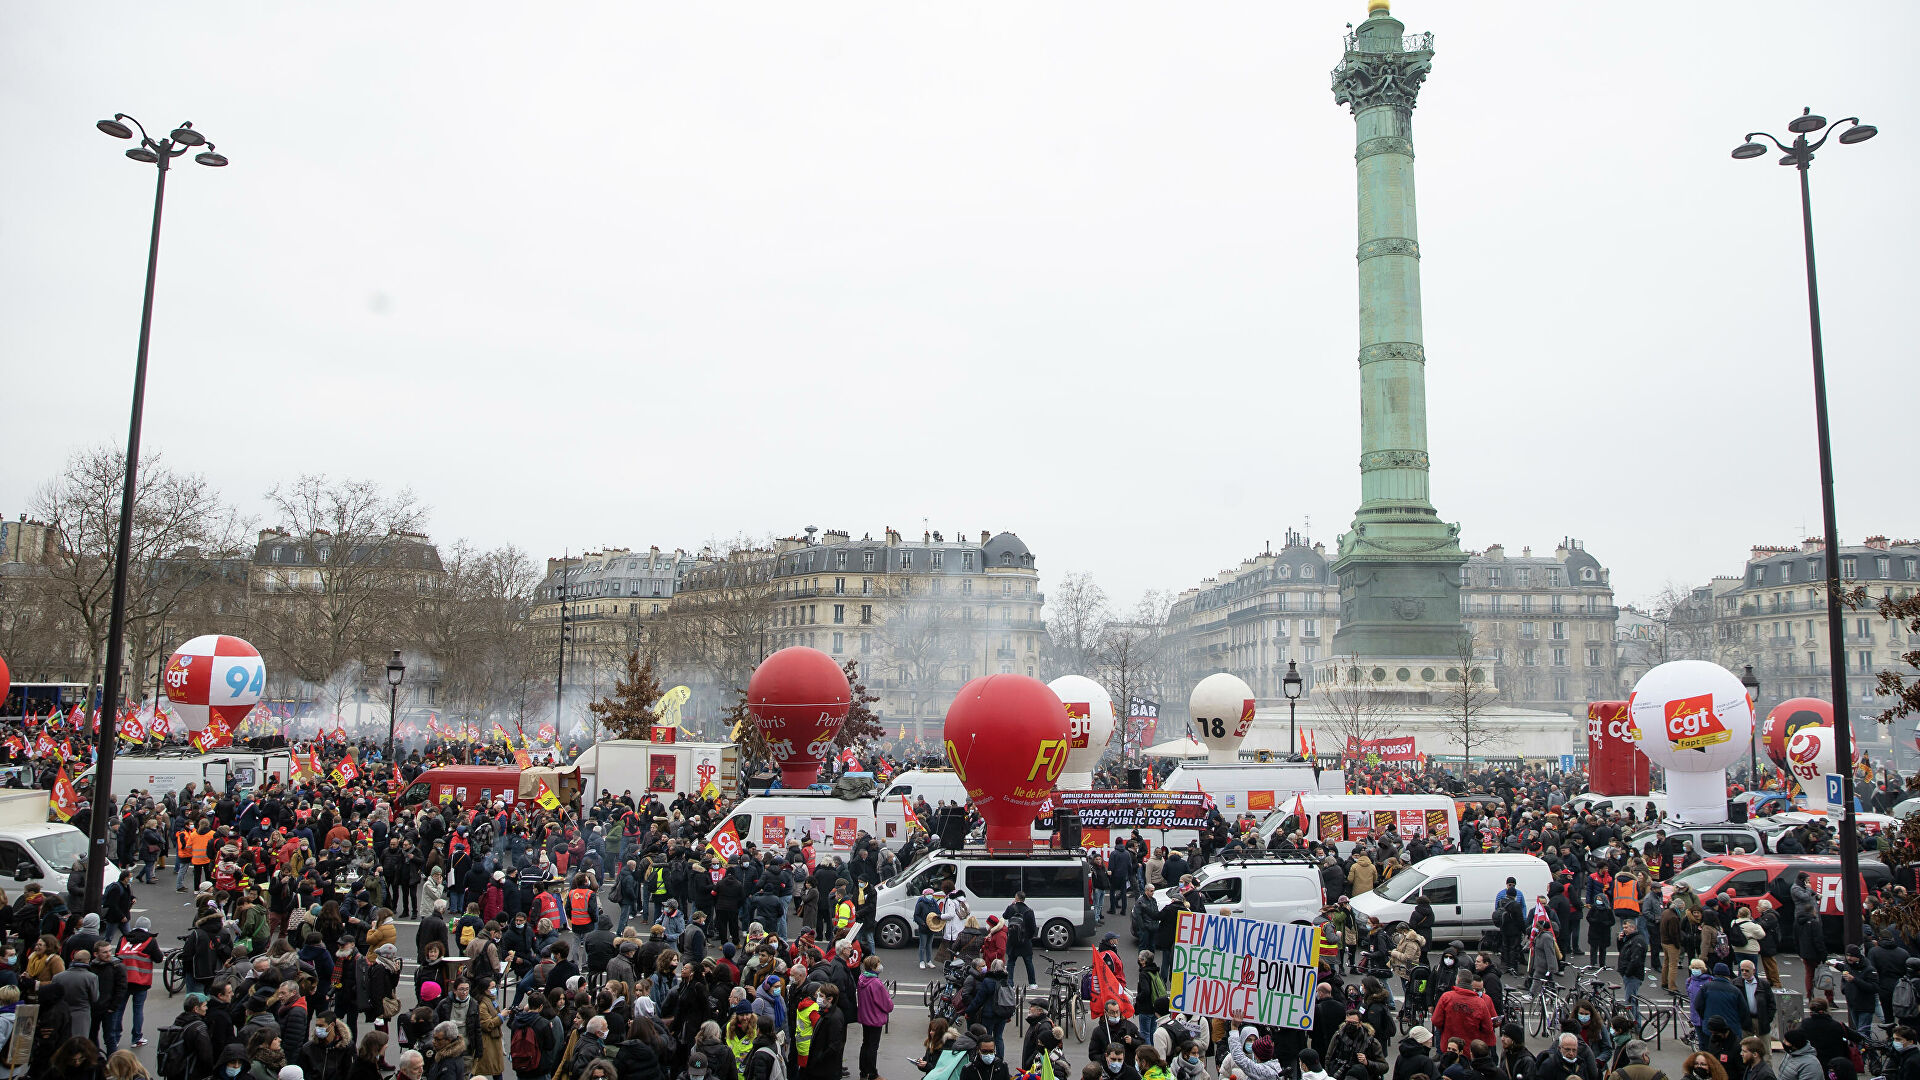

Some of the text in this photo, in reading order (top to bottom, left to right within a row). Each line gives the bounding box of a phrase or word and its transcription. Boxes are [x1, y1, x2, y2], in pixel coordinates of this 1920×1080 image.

[167, 668, 189, 688] cgt
[225, 665, 264, 697] 94
[1130, 703, 1157, 717] BAR
[1069, 713, 1090, 739] gt
[1608, 720, 1635, 743] cg
[1668, 708, 1710, 735] cgt
[1763, 717, 1775, 735] gt
[807, 738, 836, 760] cg
[1381, 743, 1413, 755] POISSY
[1681, 738, 1701, 747] fapt
[944, 740, 967, 781] O
[1027, 739, 1068, 782] FO
[1793, 763, 1820, 780] cgt
[1829, 780, 1839, 800] P
[1039, 798, 1054, 812] gt
[1078, 809, 1134, 817] GARANTIR
[1146, 809, 1176, 817] TOUS
[1081, 817, 1106, 825] VICE
[1107, 816, 1146, 825] PUBLIC
[1148, 817, 1162, 825] DE
[717, 832, 739, 858] cg
[1177, 913, 1314, 966] EH MONTCHALIN
[1239, 953, 1258, 988] le
[1257, 958, 1315, 997] POINT
[1257, 988, 1304, 1028] VITE
